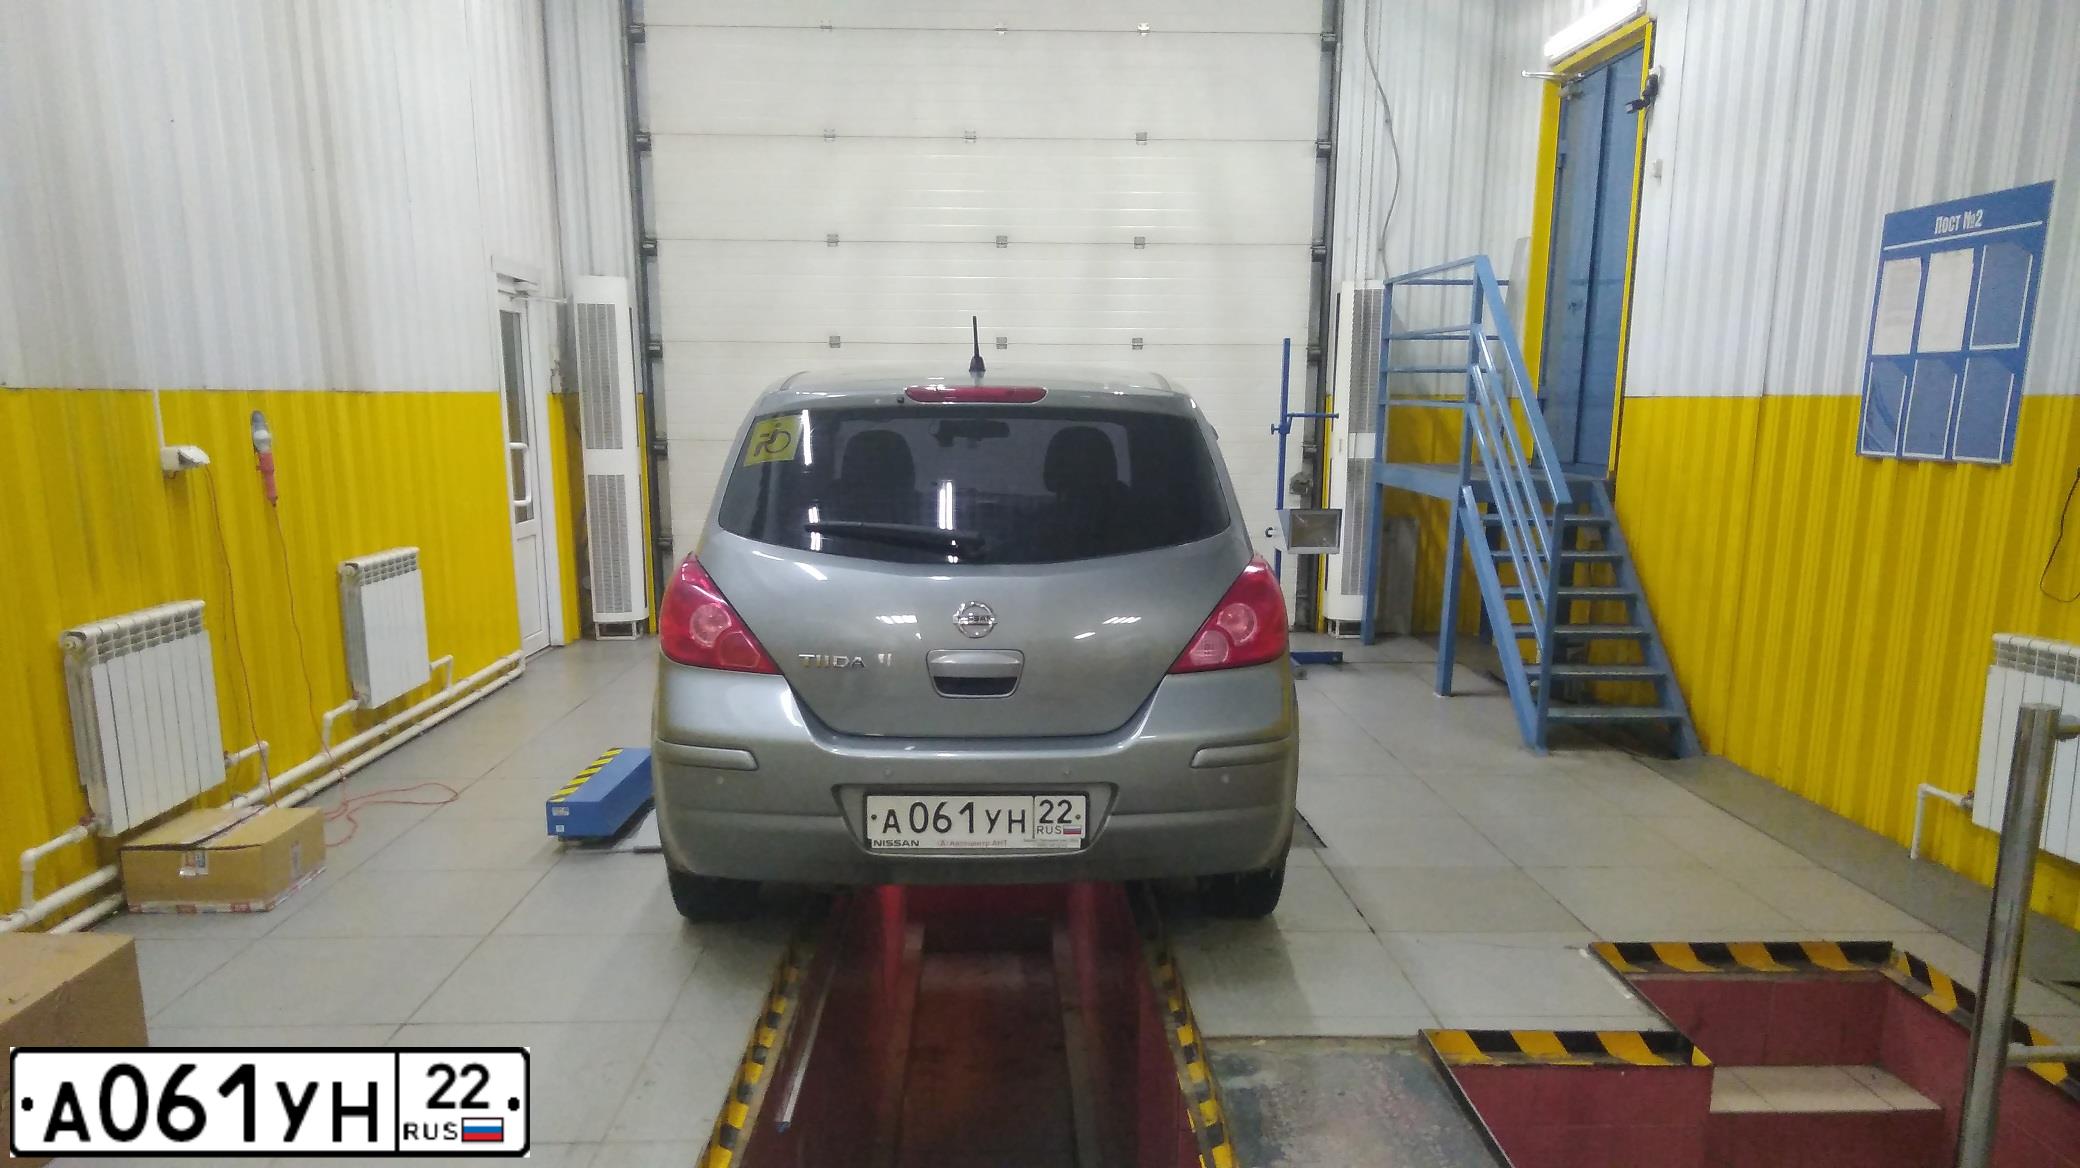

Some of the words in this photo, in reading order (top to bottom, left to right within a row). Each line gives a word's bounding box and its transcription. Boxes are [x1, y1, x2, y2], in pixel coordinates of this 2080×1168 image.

[1934, 214, 1962, 235] Пост
[1963, 209, 1984, 230] №2
[798, 653, 866, 669] TIIDA
[881, 801, 1026, 834] А061УН
[1039, 799, 1073, 824] 22
[1036, 826, 1062, 835] RUS
[873, 839, 920, 848] NISSAN
